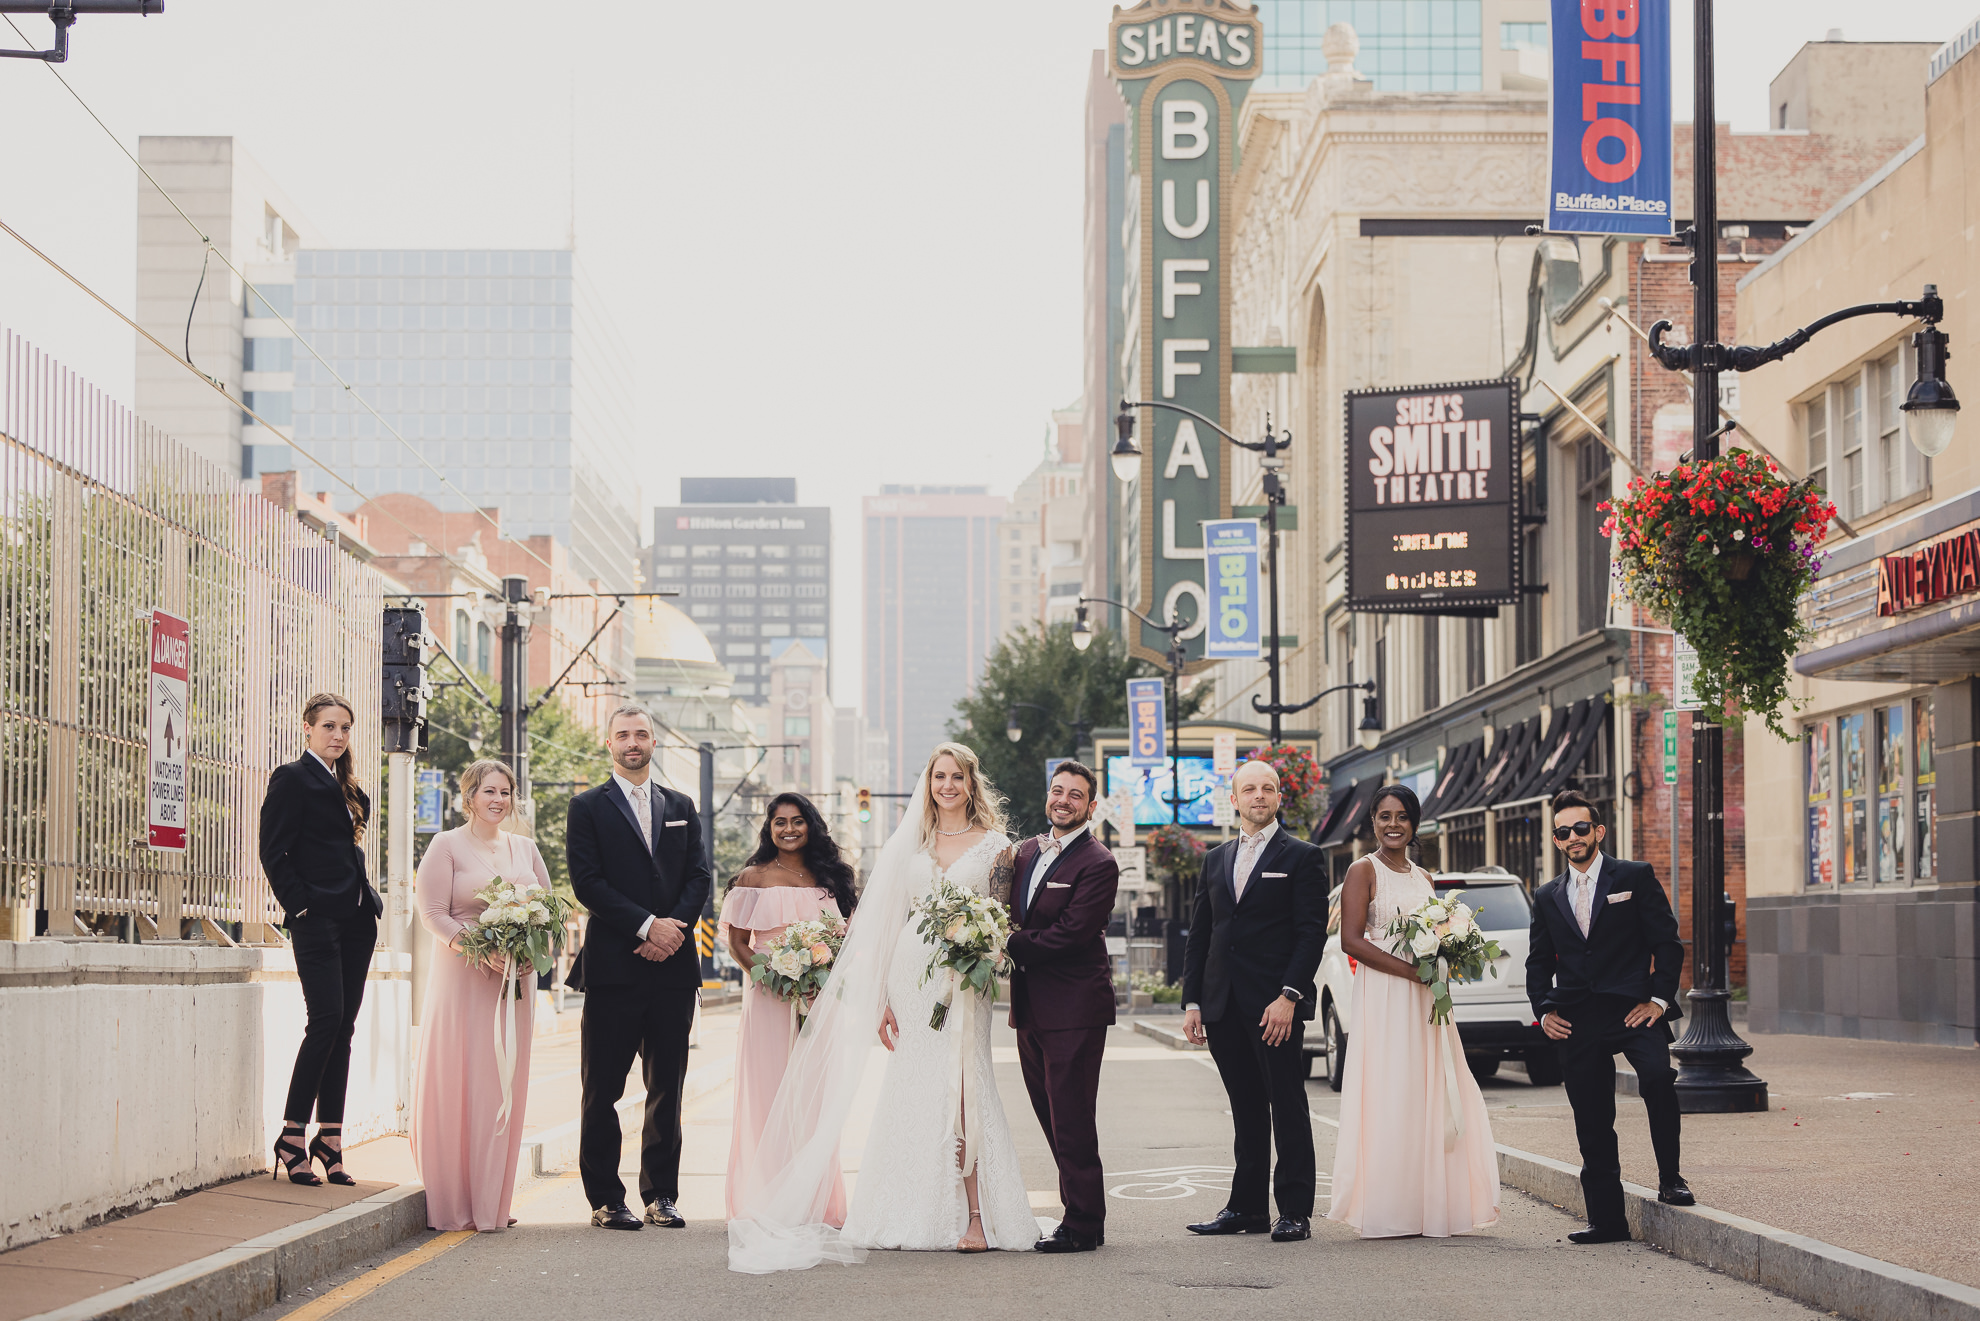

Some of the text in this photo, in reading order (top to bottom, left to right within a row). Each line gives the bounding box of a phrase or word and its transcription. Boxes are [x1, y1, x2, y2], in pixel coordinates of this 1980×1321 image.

[1120, 15, 1251, 66] SHEA'S
[1580, 0, 1642, 184] BFLO
[1556, 192, 1667, 212] Buffalo Place
[1161, 99, 1210, 640] BUFFALO
[1396, 394, 1464, 425] SHEA'S
[1368, 418, 1492, 477] SMITH
[1373, 470, 1488, 505] THEATRE
[733, 517, 780, 530] Garden
[781, 517, 806, 530] Inn
[1218, 554, 1248, 638] BFLO
[160, 633, 187, 670] DANGER
[1137, 702, 1158, 756] BFLO
[155, 760, 183, 781] WATCH FOR
[152, 781, 184, 802] POWER LINES
[160, 803, 177, 822] ABOVE
